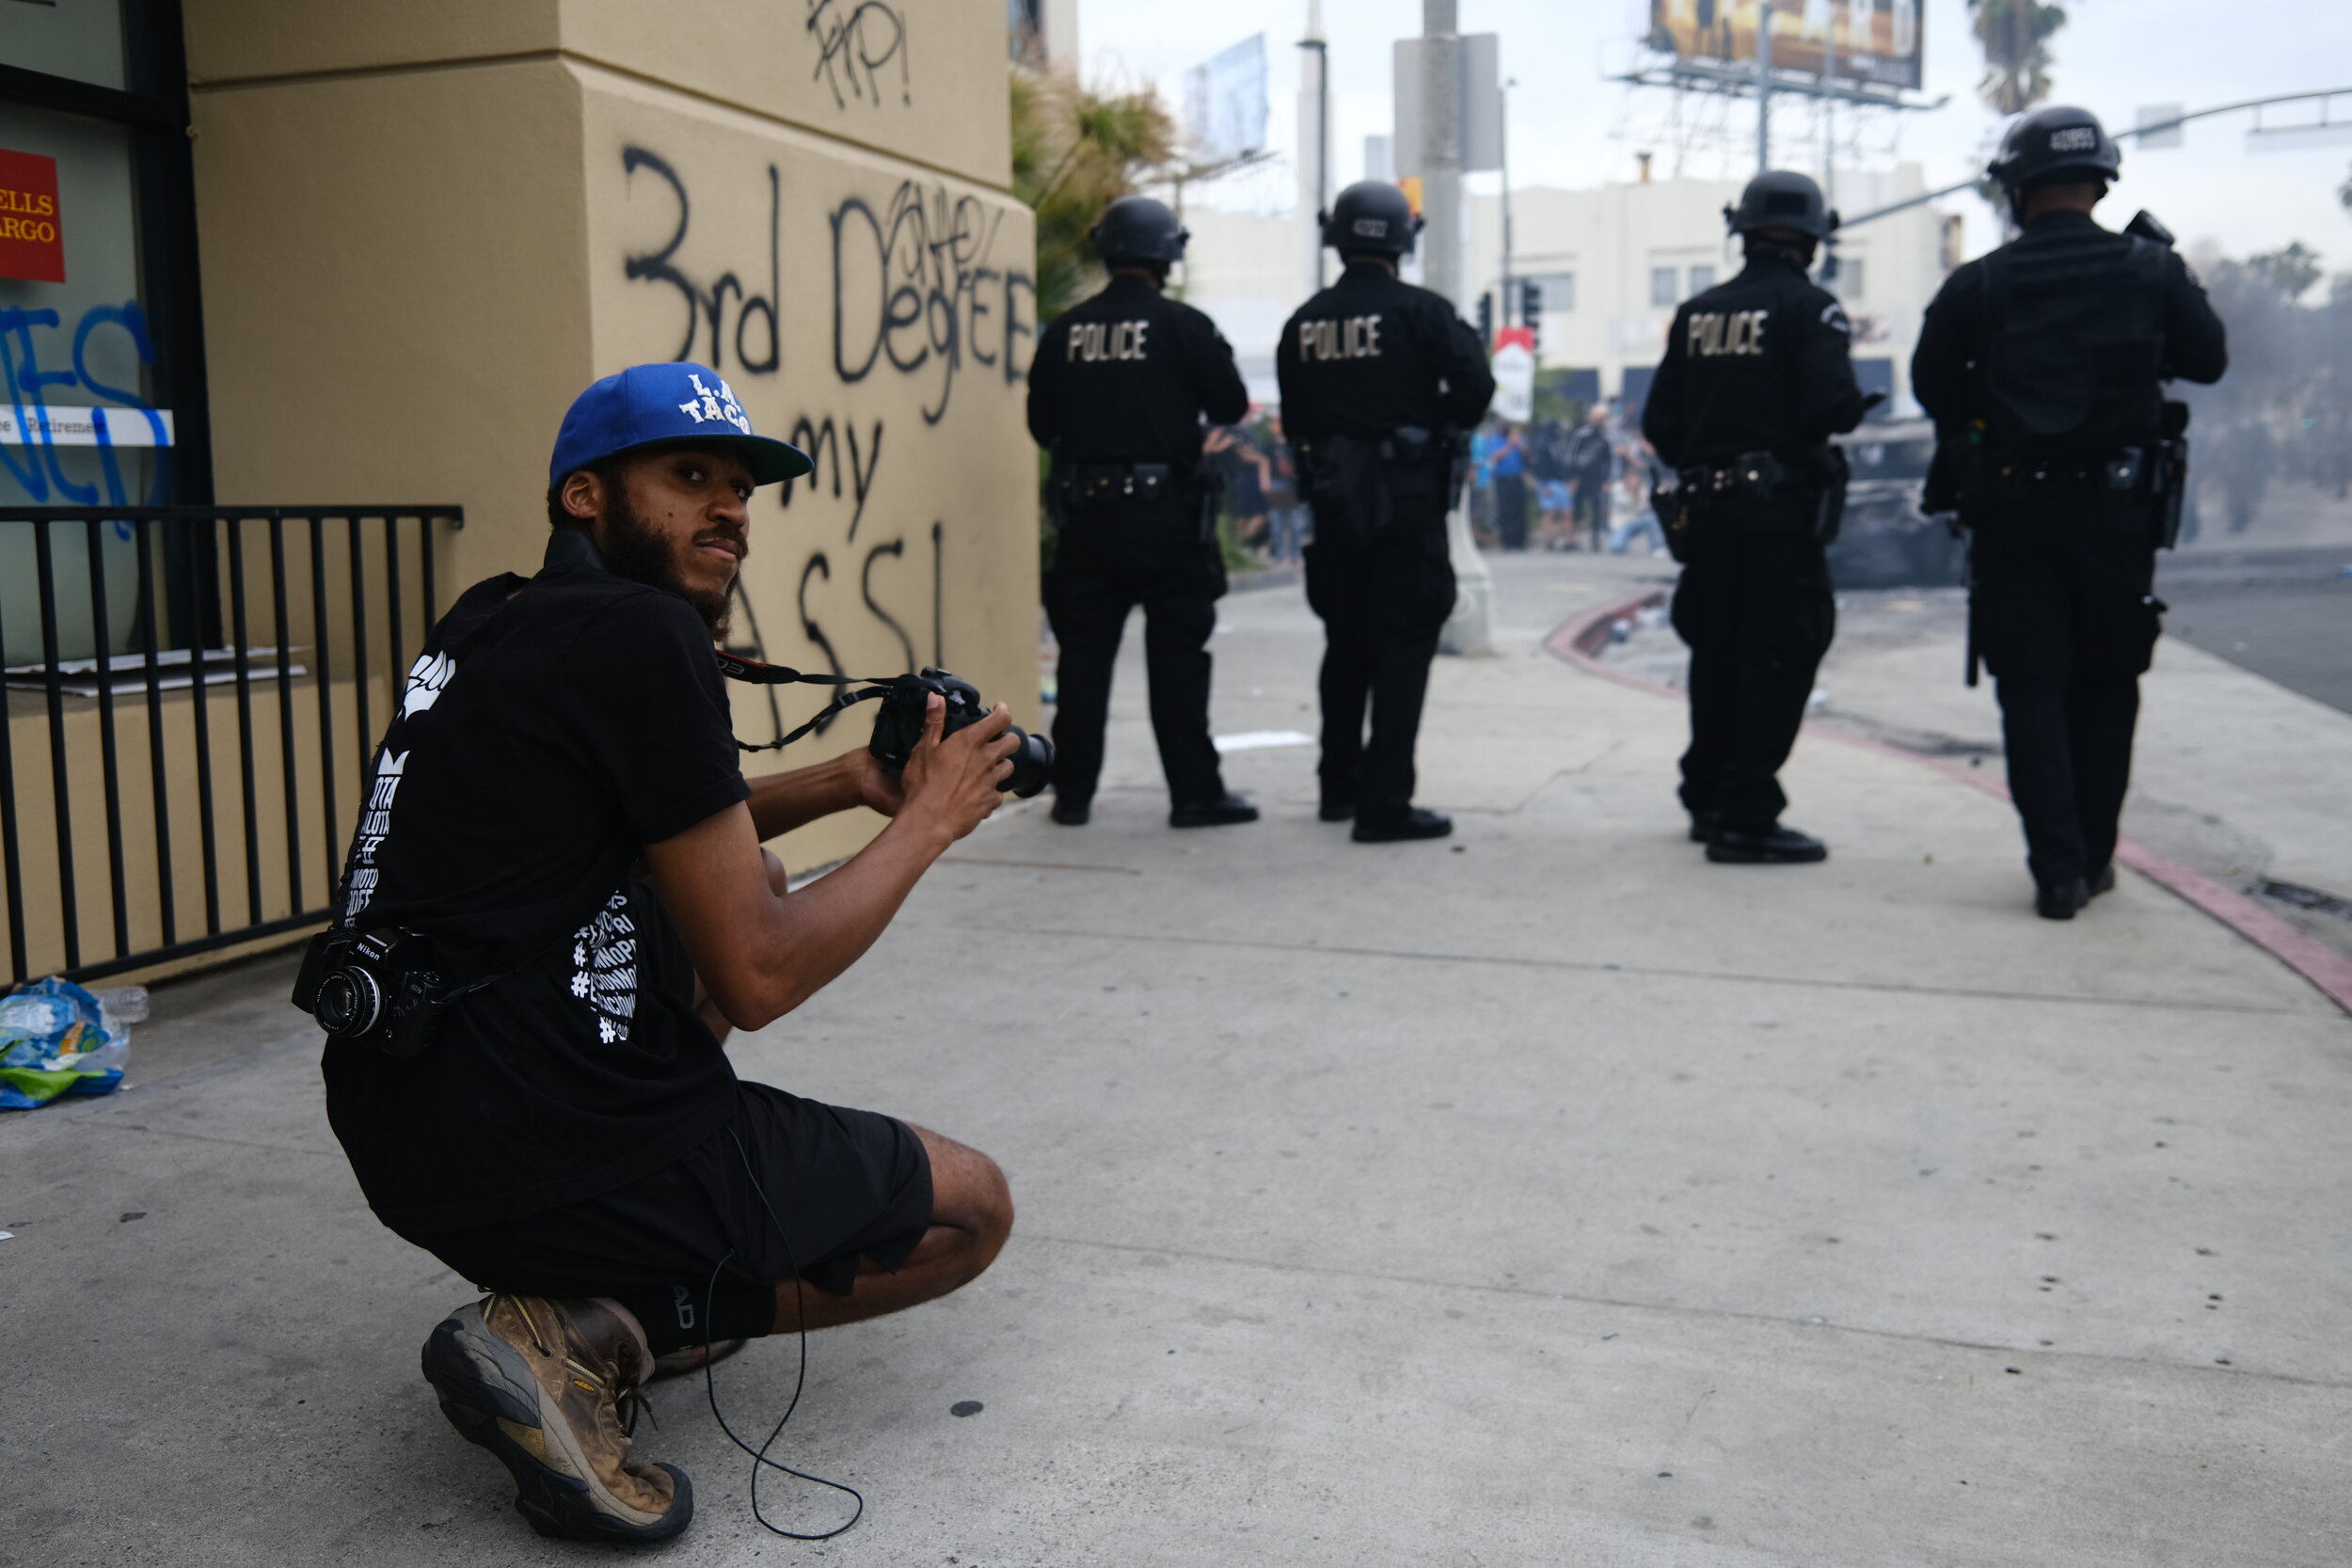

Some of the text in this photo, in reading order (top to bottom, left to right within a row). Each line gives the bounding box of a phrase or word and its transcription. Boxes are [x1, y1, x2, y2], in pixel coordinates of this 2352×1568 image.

[0, 217, 56, 243] RGO
[621, 145, 780, 374] 3rd
[1067, 320, 1150, 361] POLICE
[1300, 314, 1382, 361] POLICE
[1688, 309, 1769, 356] POLICE
[678, 396, 751, 436] TACO
[358, 942, 380, 960] Nikon
